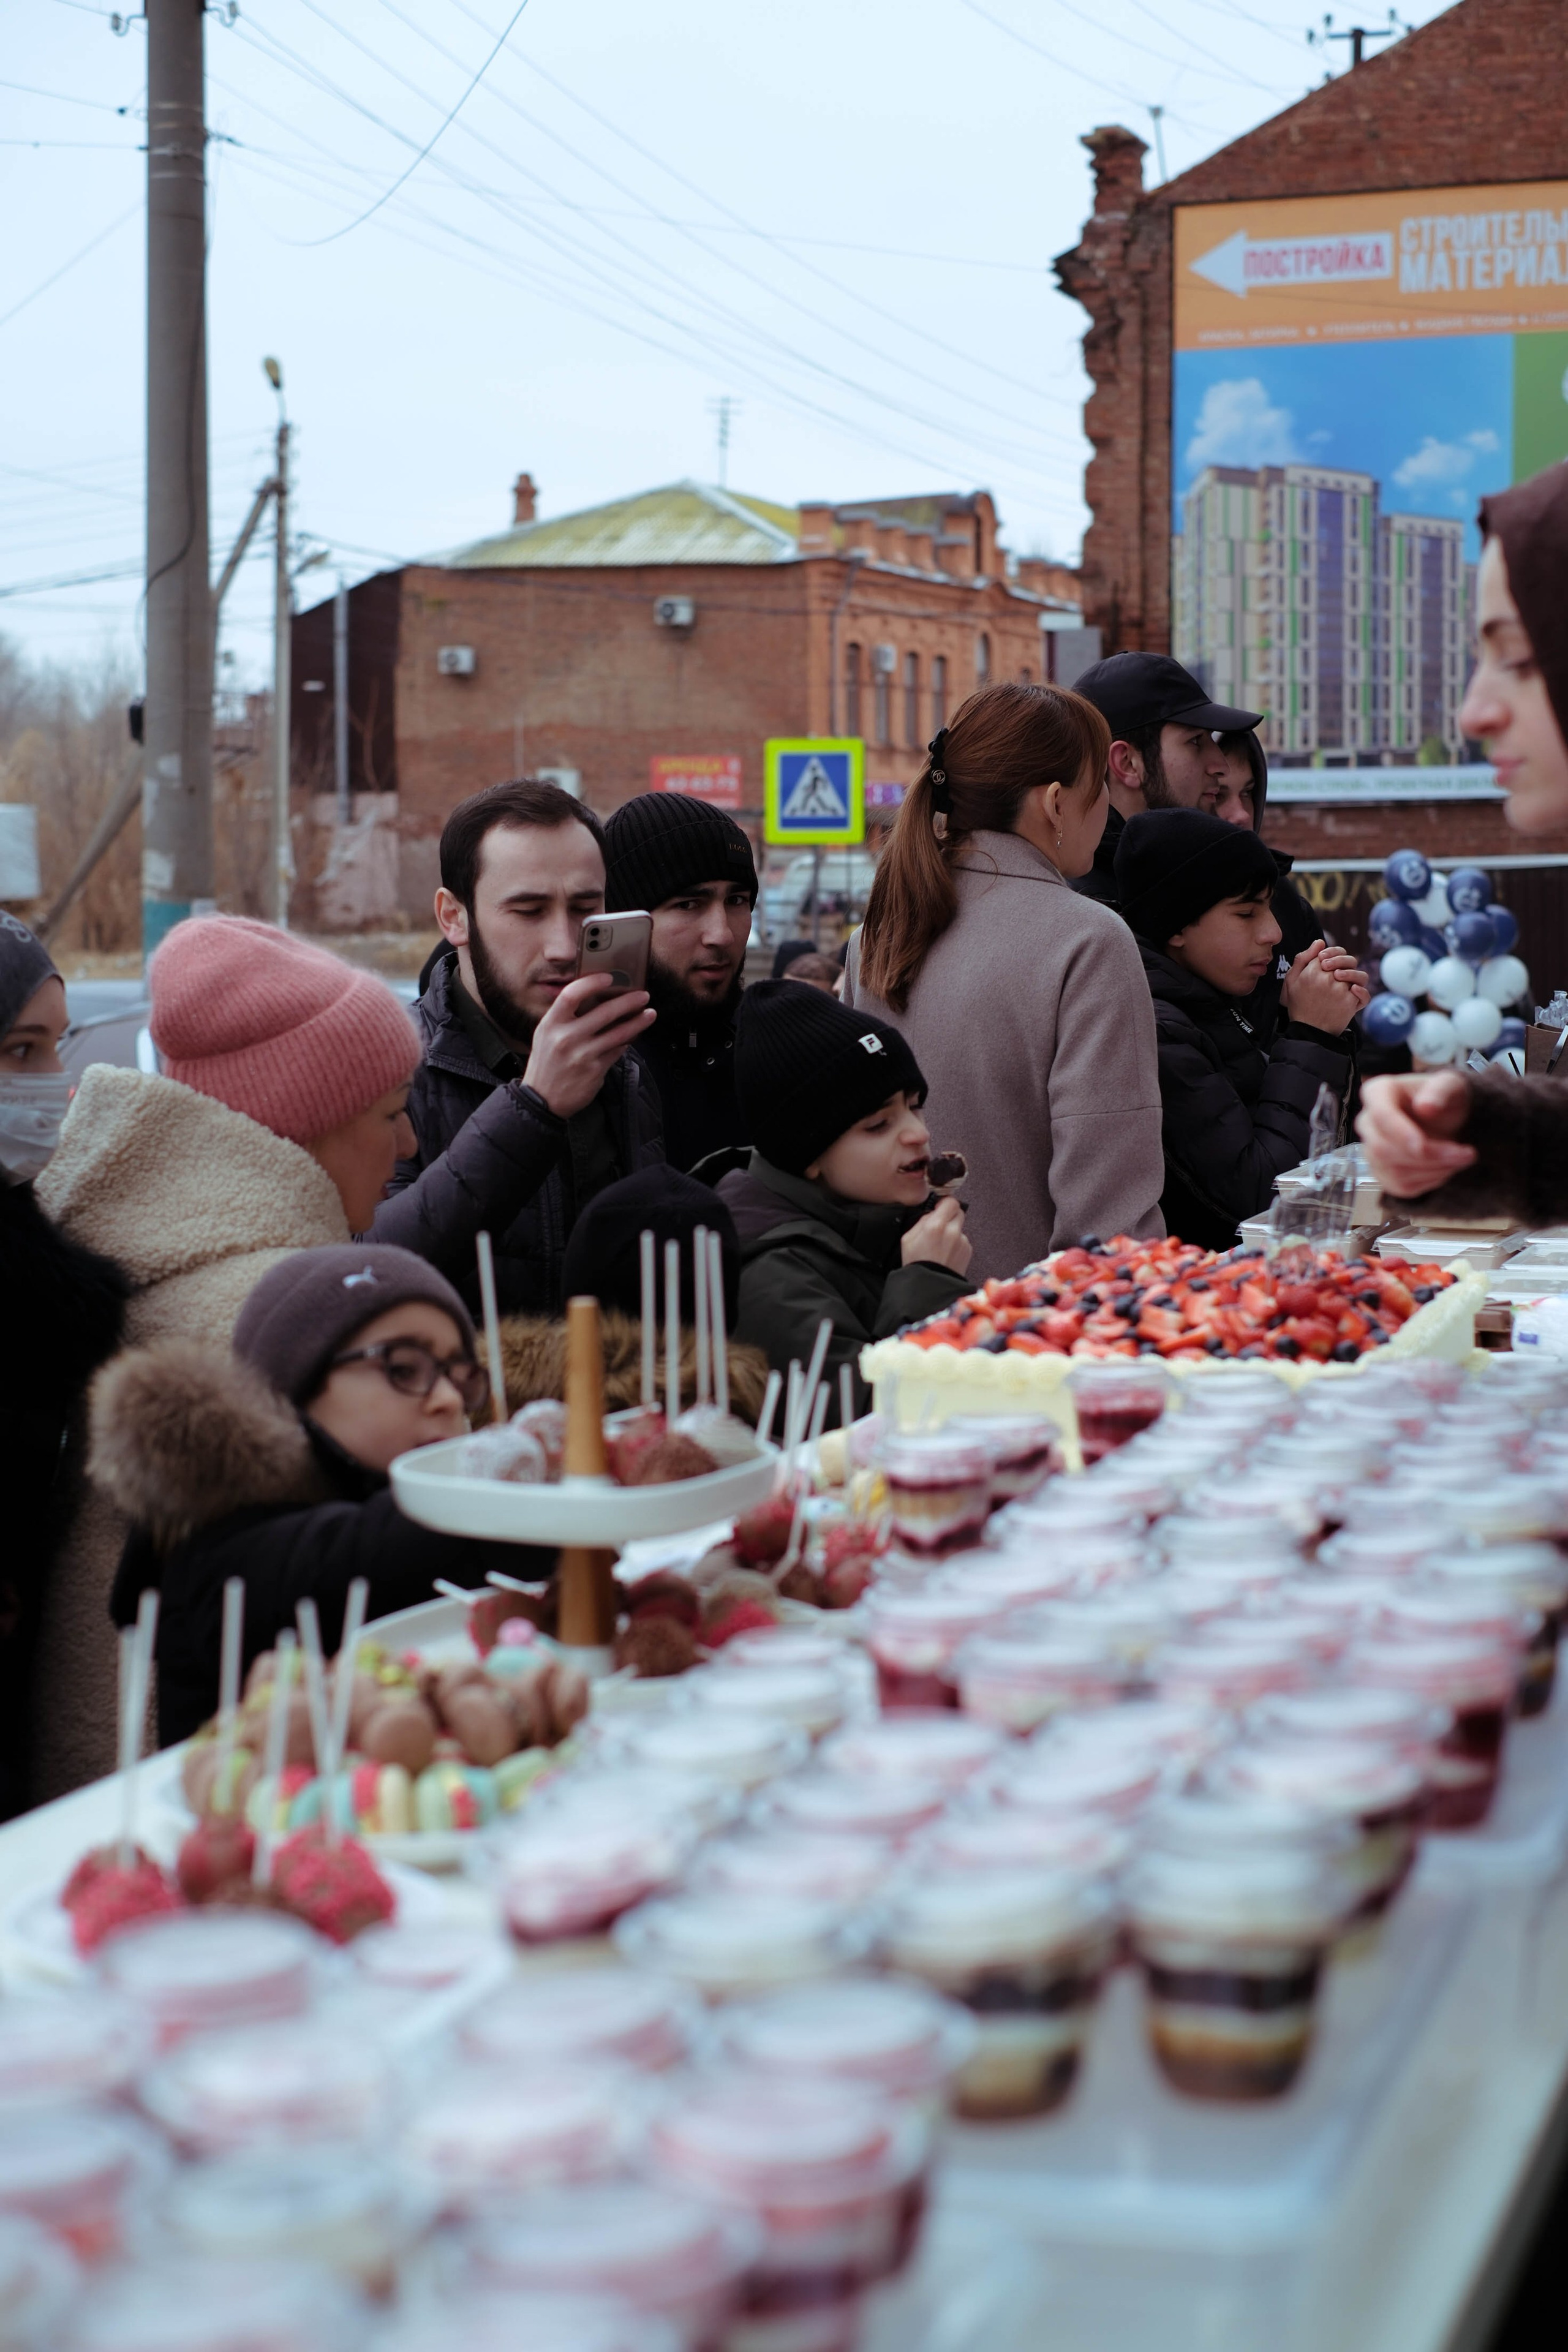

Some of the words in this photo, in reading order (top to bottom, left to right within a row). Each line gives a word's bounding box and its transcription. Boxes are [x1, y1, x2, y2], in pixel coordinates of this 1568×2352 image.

[1243, 239, 1384, 278] ПОСТРОЙКА
[1399, 245, 1568, 293] МАТЕРИА
[1239, 1021, 1253, 1034] TIME
